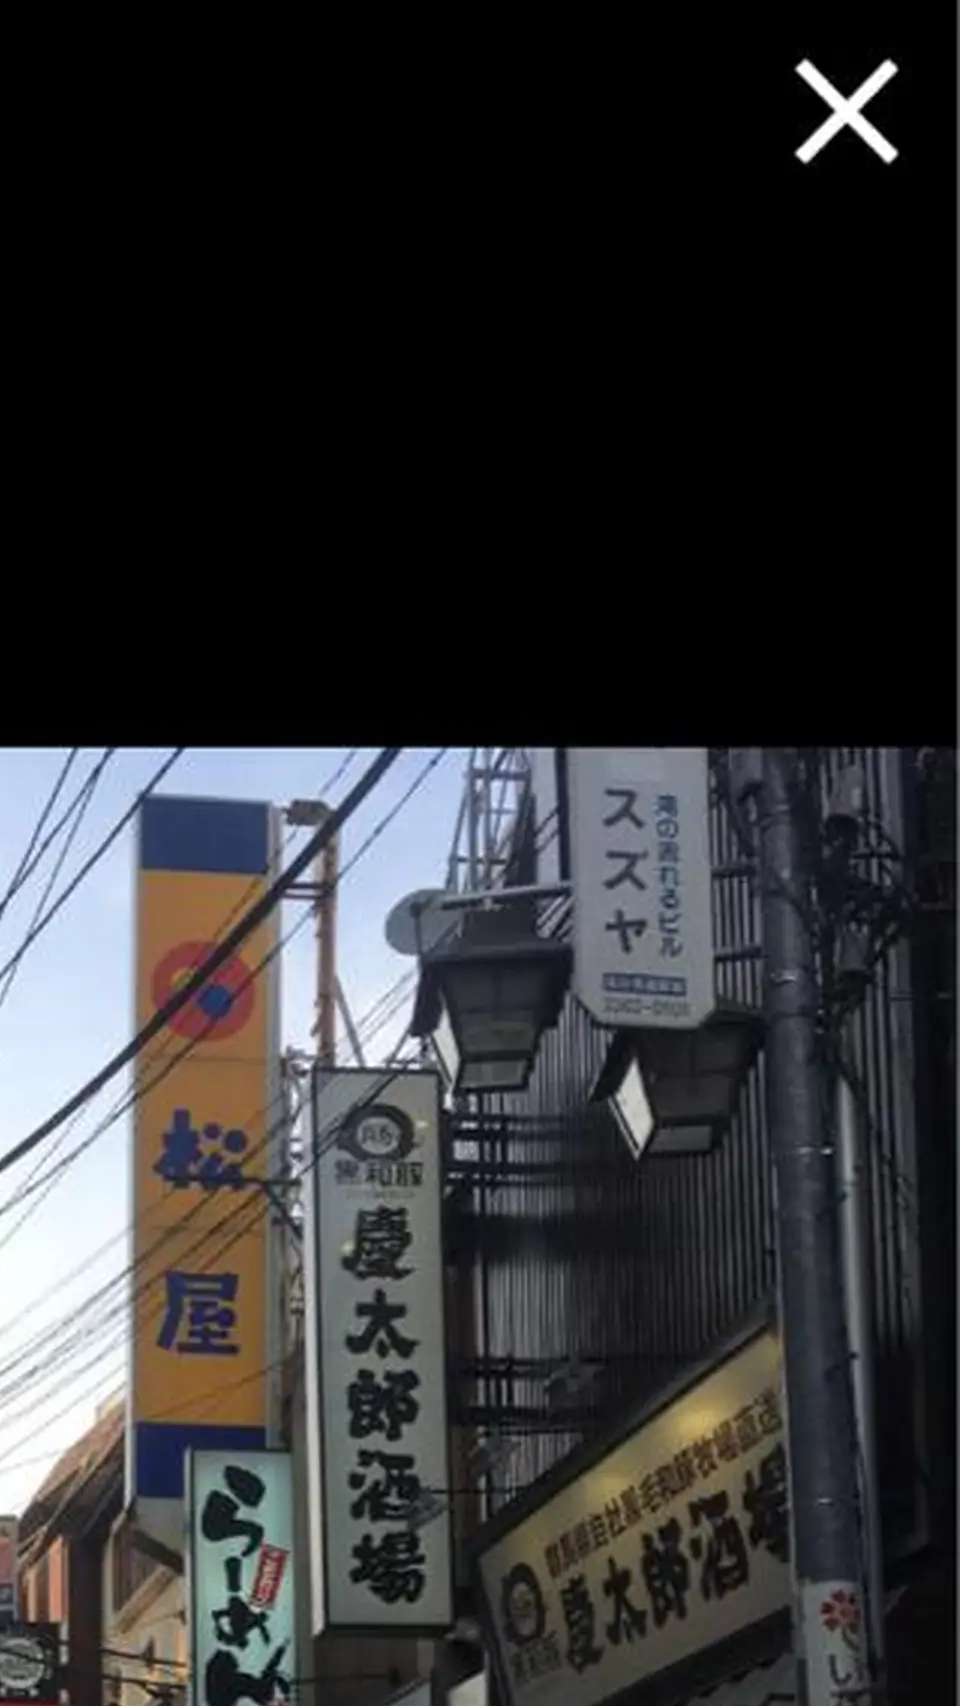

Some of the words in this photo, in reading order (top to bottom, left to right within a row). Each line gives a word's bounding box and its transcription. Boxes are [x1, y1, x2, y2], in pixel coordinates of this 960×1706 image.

[602, 788, 649, 955] スズヤ
[153, 1108, 248, 1356] 松屋
[342, 1206, 428, 1606] 慶太郎酒場
[559, 1440, 790, 1675] 慶太郎酒場
